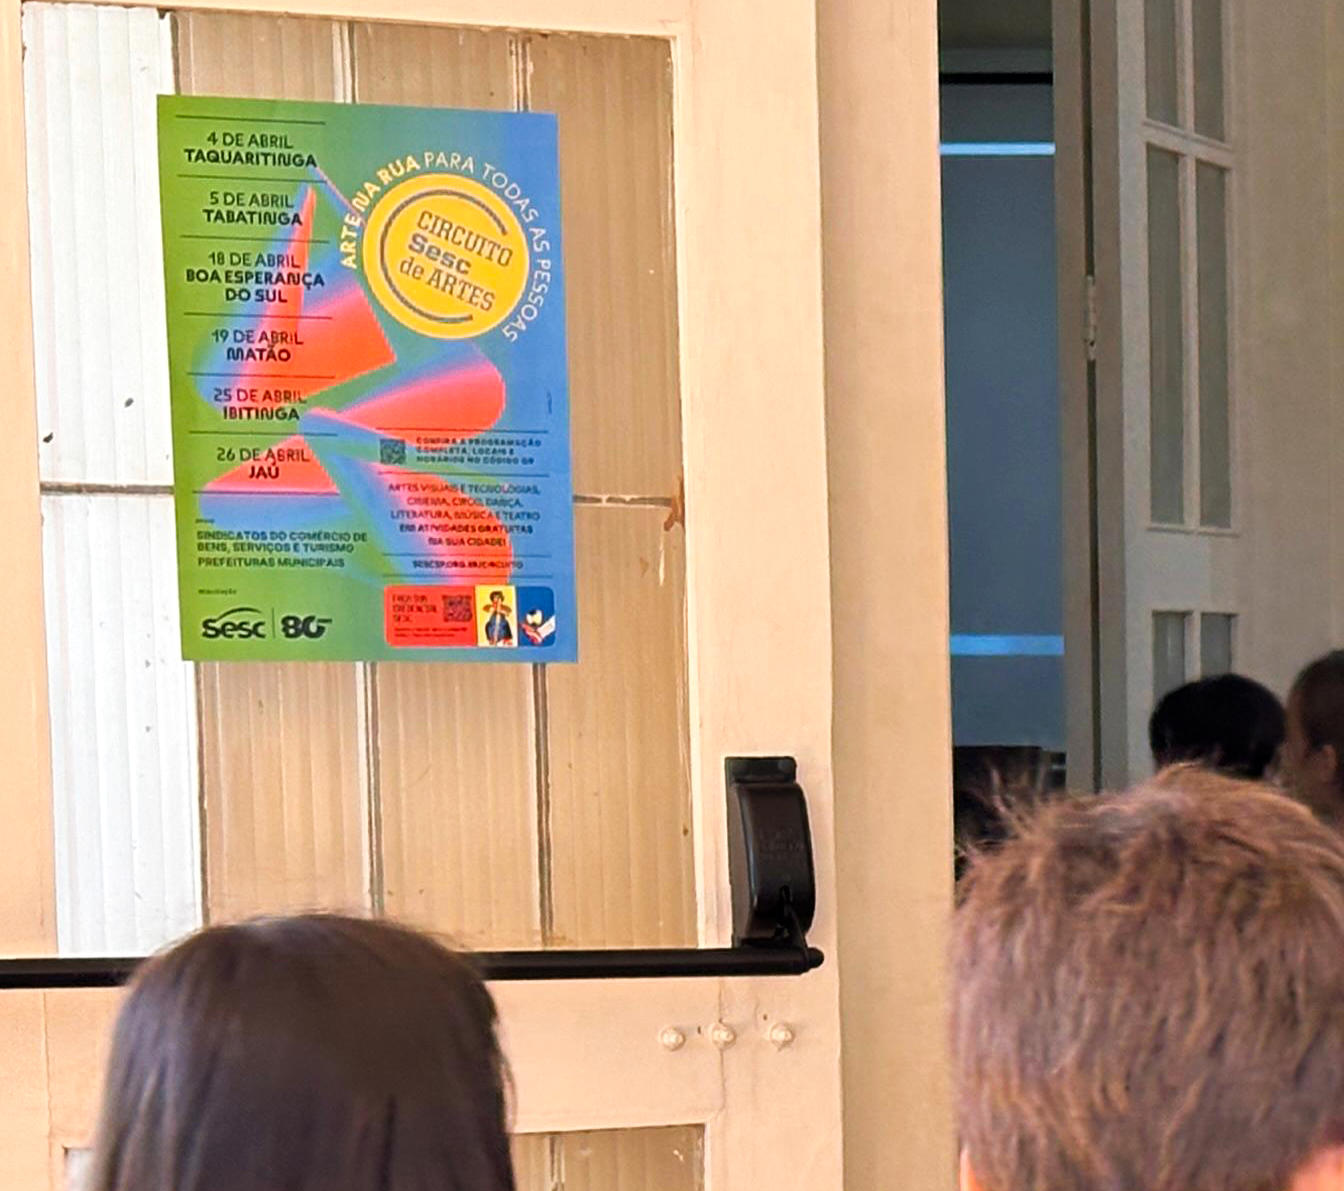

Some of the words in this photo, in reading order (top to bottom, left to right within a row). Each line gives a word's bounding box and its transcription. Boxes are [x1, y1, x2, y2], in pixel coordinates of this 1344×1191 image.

[207, 131, 218, 146] 4
[222, 132, 244, 147] DE
[248, 133, 294, 149] ABRIL
[184, 148, 317, 167] TAQUARITINGA
[424, 151, 474, 174] PARA
[376, 155, 421, 186] RUA
[209, 190, 219, 205] 5
[223, 192, 245, 207] DE
[248, 193, 294, 208] ABRIL
[352, 181, 381, 212] NA
[482, 163, 539, 223] TODAS
[202, 208, 303, 226] TABATINGA
[340, 212, 361, 270] ARTE
[417, 209, 514, 268] CIRCUITO
[529, 227, 551, 253] AS
[208, 251, 226, 266] 18
[229, 252, 252, 267] DE
[254, 253, 301, 268] ABRIL
[408, 232, 472, 275] Sesc
[186, 268, 222, 284] BOA
[224, 270, 325, 290] ESPERANÇA
[399, 256, 425, 281] de
[425, 267, 496, 312] ARTES
[225, 288, 251, 302] DO
[255, 289, 288, 303] SUL
[502, 258, 552, 342] PESSOAS
[211, 329, 229, 343] 19
[233, 329, 255, 344] DE
[258, 330, 304, 345] ABRIL
[226, 344, 291, 362] MATÃO
[213, 388, 232, 402] 25
[236, 388, 258, 402] DE
[262, 389, 307, 404] ABRIL
[222, 406, 300, 421] IBITINGA
[216, 447, 235, 462] 26
[239, 447, 262, 462] DE
[264, 448, 310, 462] ABRIL
[248, 457, 280, 479] JAÚ
[388, 483, 419, 493] ARTES
[502, 511, 541, 522] TEATRO
[197, 530, 268, 542] SINDICATOS
[270, 531, 287, 542] DO
[289, 529, 352, 542] COMÉRCIO
[354, 532, 368, 542] DE
[197, 542, 231, 554] BENS,
[233, 542, 291, 555] SERVIÇOS
[302, 543, 355, 554] TURISMO
[198, 556, 275, 568] PREFEITURAS
[277, 557, 345, 568] MUNICIPAIS
